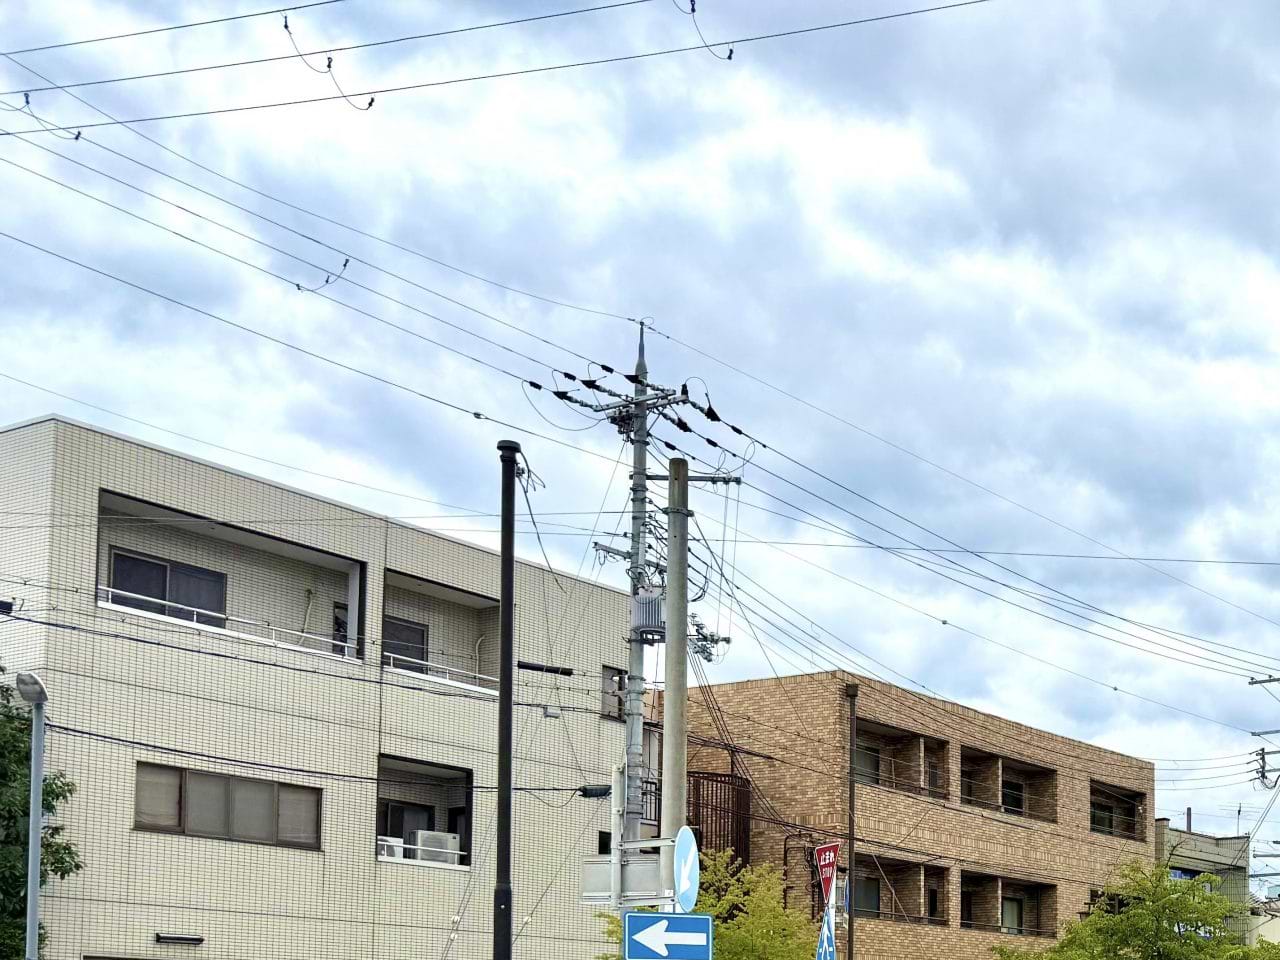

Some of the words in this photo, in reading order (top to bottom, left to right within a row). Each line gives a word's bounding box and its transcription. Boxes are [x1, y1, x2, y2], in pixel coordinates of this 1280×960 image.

[820, 849, 835, 866] 止まれ
[822, 866, 833, 878] STOP
